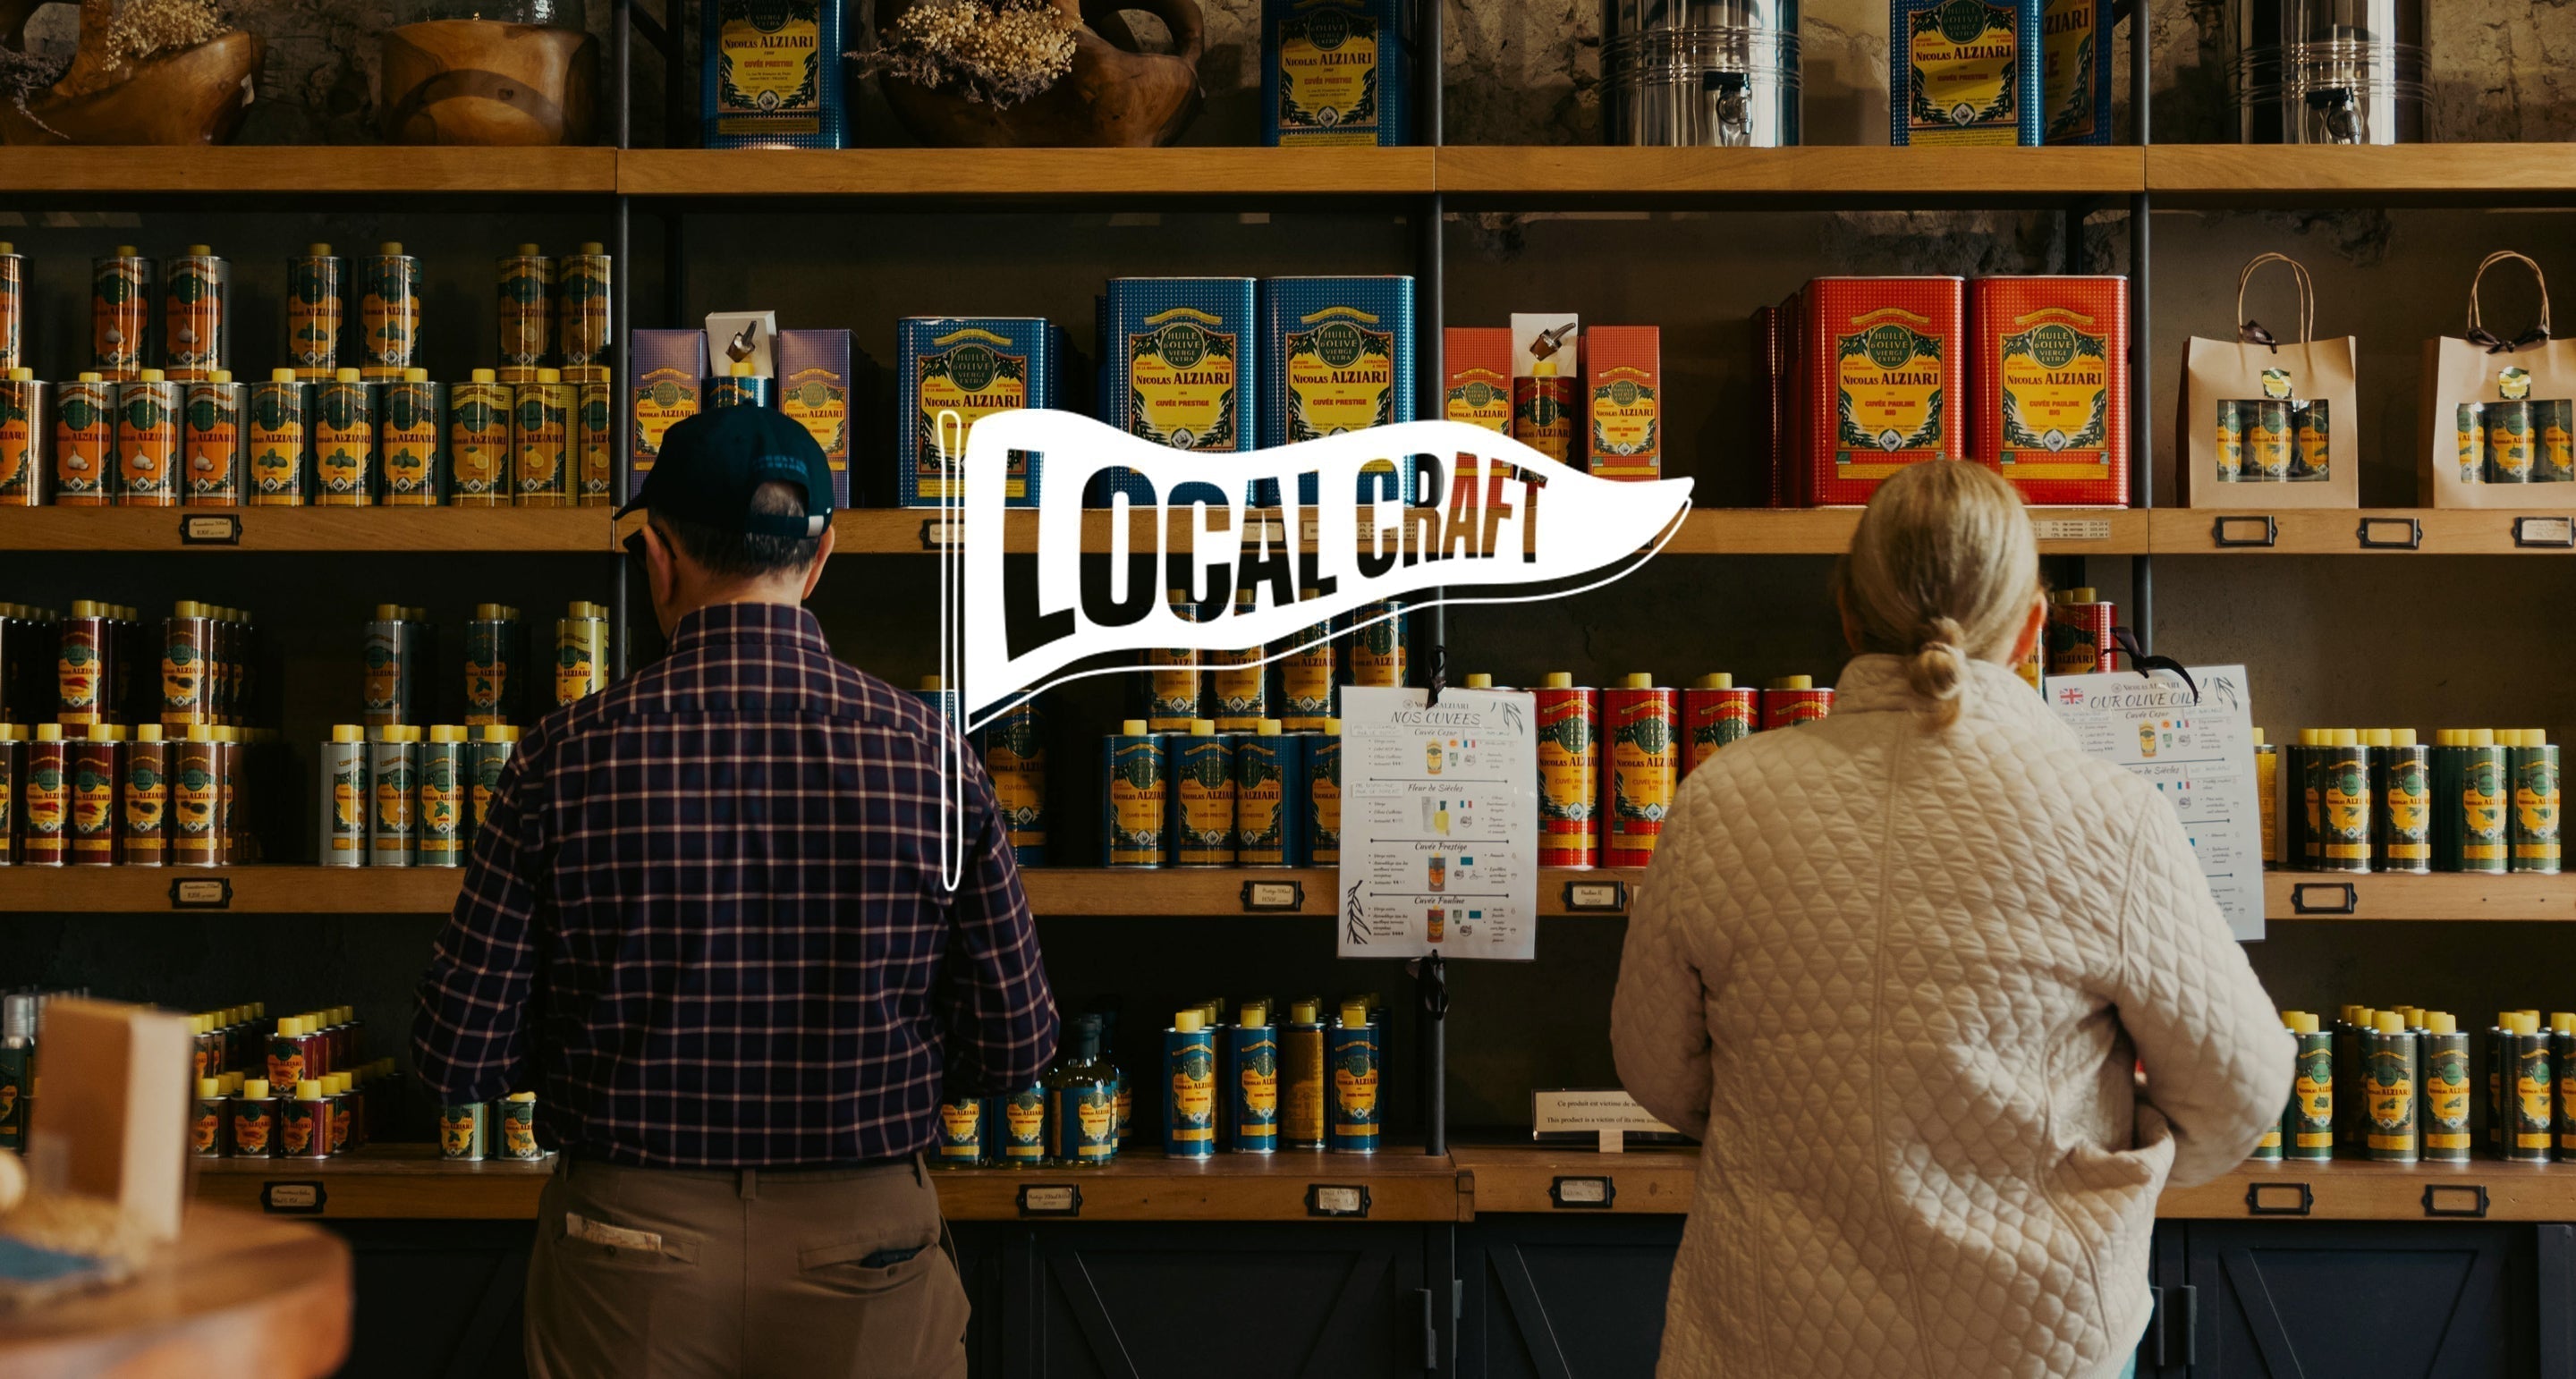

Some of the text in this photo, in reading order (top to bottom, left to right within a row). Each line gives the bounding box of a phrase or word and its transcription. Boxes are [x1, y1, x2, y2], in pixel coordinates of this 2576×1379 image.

[2046, 8, 2089, 35] ZIARI
[724, 37, 814, 49] NICOLAS ALZIARI
[1916, 45, 2011, 62] NICOLAS ALZIARI
[1285, 53, 1371, 67] NICOLAS ALZIARI
[1167, 331, 1199, 340] HUILE
[1325, 330, 1353, 339] HUILE
[1876, 332, 1904, 340] HUILE
[2038, 332, 2069, 340] HUILE
[957, 353, 986, 362] HUILE
[1136, 372, 1230, 385] NICOLAS ALZIARI
[1293, 371, 1387, 385] NICOLAS ALZIARI
[1843, 372, 1938, 385] NICOLAS ALZIARI
[2007, 372, 2102, 385] NICOLAS ALZIARI
[925, 394, 1021, 408] NICOLAS ALZIARI
[1156, 399, 1176, 407] CUVÉE
[1313, 398, 1334, 406] CUVÉE
[1865, 399, 1885, 407] CUVÉE
[2029, 399, 2050, 407] CUVÉE
[809, 410, 843, 419] ALZIARI
[1473, 410, 1506, 419] ALZIARI
[1619, 409, 1654, 417] ALZIARI
[72, 432, 112, 443] ALZIARI
[198, 433, 234, 443] ALZIARI
[266, 434, 303, 444] ALZIARI
[334, 434, 371, 444] ALZIARI
[398, 434, 436, 444] ALZIARI
[527, 434, 563, 444] ALZIARI
[2090, 696, 2121, 709] OUR
[2125, 692, 2166, 707] OLIVE
[1391, 711, 1422, 724] NOS
[2125, 711, 2147, 719] Cuvée
[1414, 728, 1436, 736] Cuvée
[1539, 758, 1568, 767] NICOLAS
[1616, 759, 1644, 768] NICOLAS
[1408, 783, 1427, 792] Fleur
[1428, 783, 1436, 791] de
[1244, 791, 1279, 800] ALZIARI
[1415, 842, 1468, 853] Cuvée Prestige
[1414, 895, 1465, 905] Cuvée Pauline
[1568, 1100, 1589, 1108] produit
[1561, 1116, 1583, 1124] product
